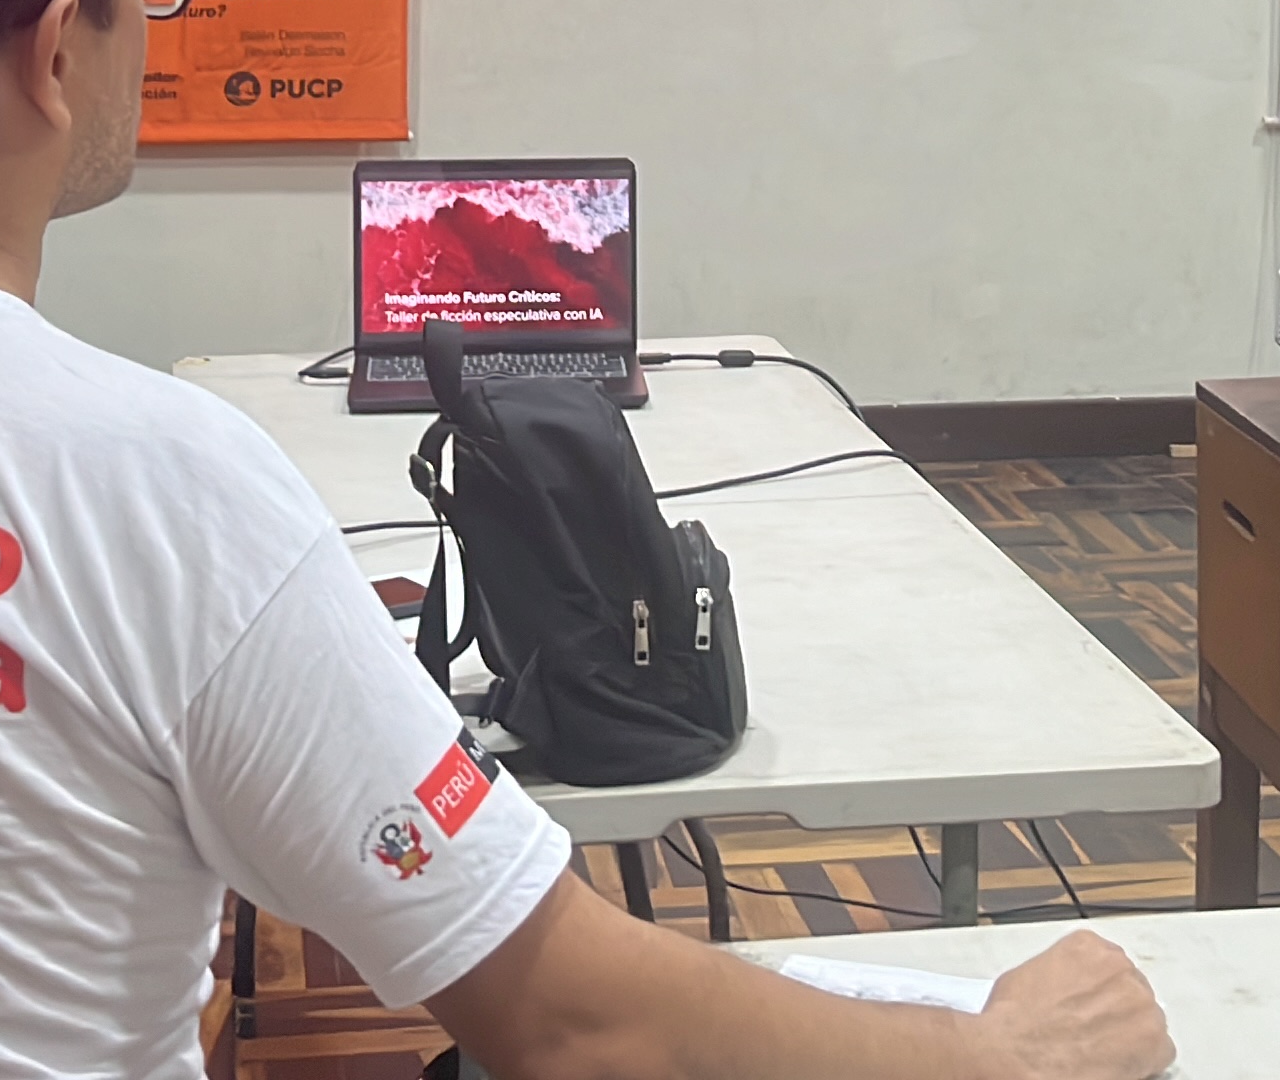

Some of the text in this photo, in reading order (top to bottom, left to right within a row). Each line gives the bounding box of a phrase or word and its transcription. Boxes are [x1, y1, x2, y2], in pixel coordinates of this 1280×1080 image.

[270, 78, 344, 99] PUCP
[384, 290, 562, 308] Imaginando Futuro Críticos:
[385, 310, 418, 324] Taller
[441, 308, 482, 323] ficción
[483, 307, 561, 325] especulativa
[563, 309, 588, 322] con
[589, 308, 604, 321] IA
[431, 760, 477, 818] PERÚ
